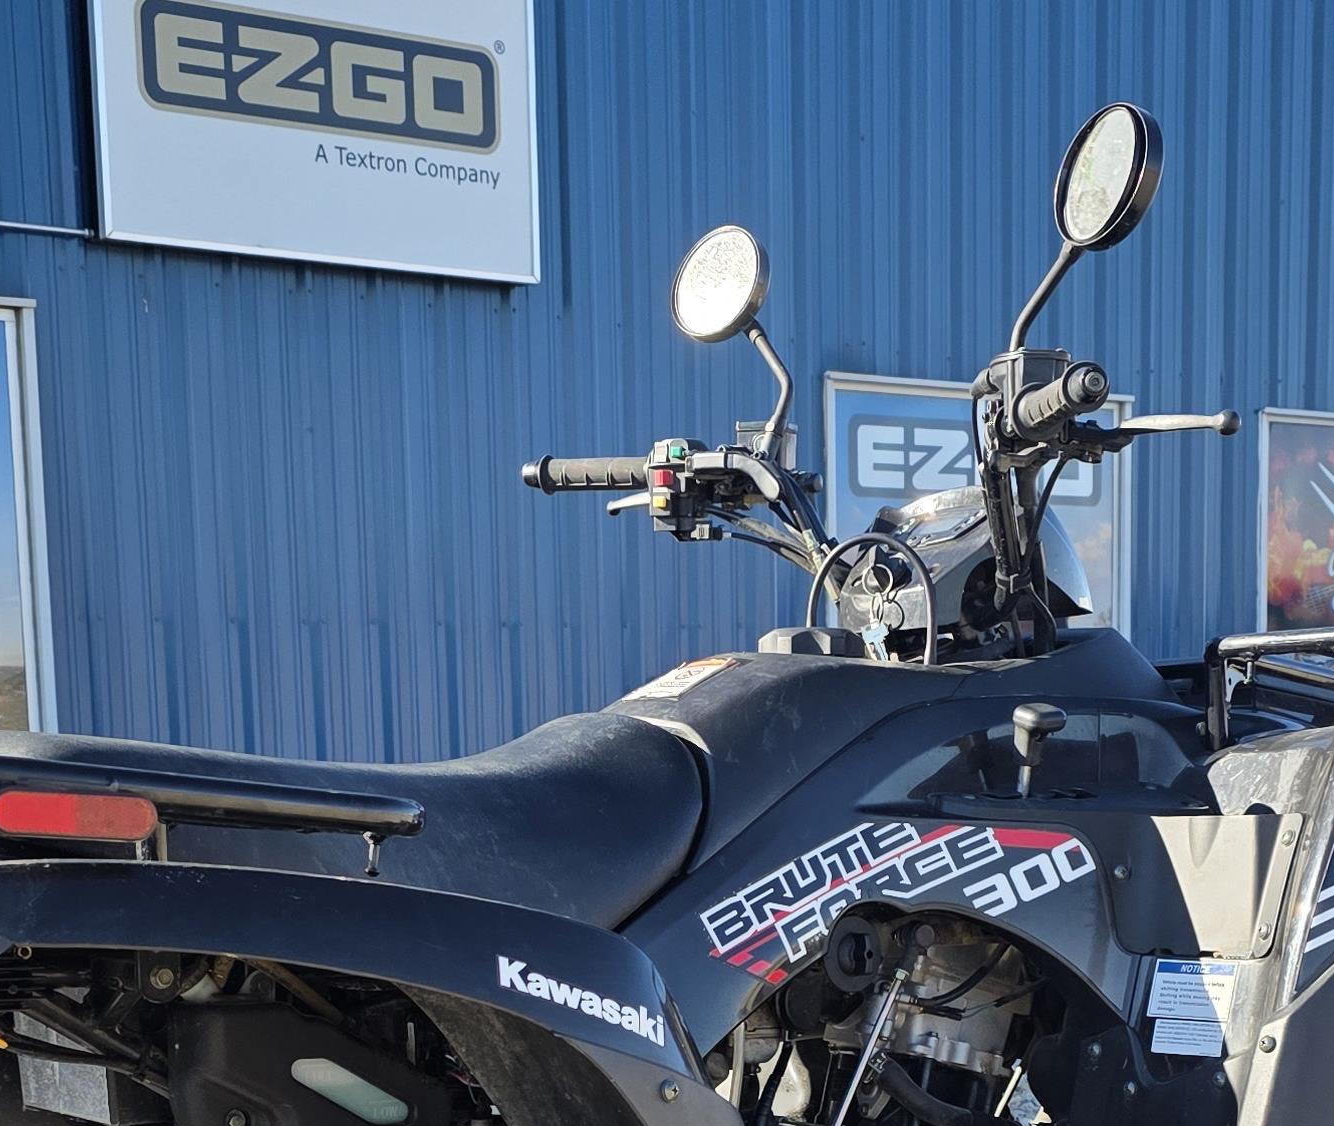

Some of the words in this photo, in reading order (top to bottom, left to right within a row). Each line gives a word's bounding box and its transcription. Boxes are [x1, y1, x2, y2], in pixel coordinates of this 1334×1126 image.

[153, 12, 485, 137] EZGO
[314, 144, 328, 164] A
[334, 146, 408, 173] Textron
[414, 157, 501, 190] Company
[857, 424, 1094, 498] EZO
[700, 822, 922, 955] BRUTE
[775, 825, 1005, 964] FORCE
[963, 838, 1096, 917] 300
[498, 956, 665, 1048] Kawasaki
[1180, 964, 1211, 974] NOTICE
[373, 1105, 399, 1119] LOW
